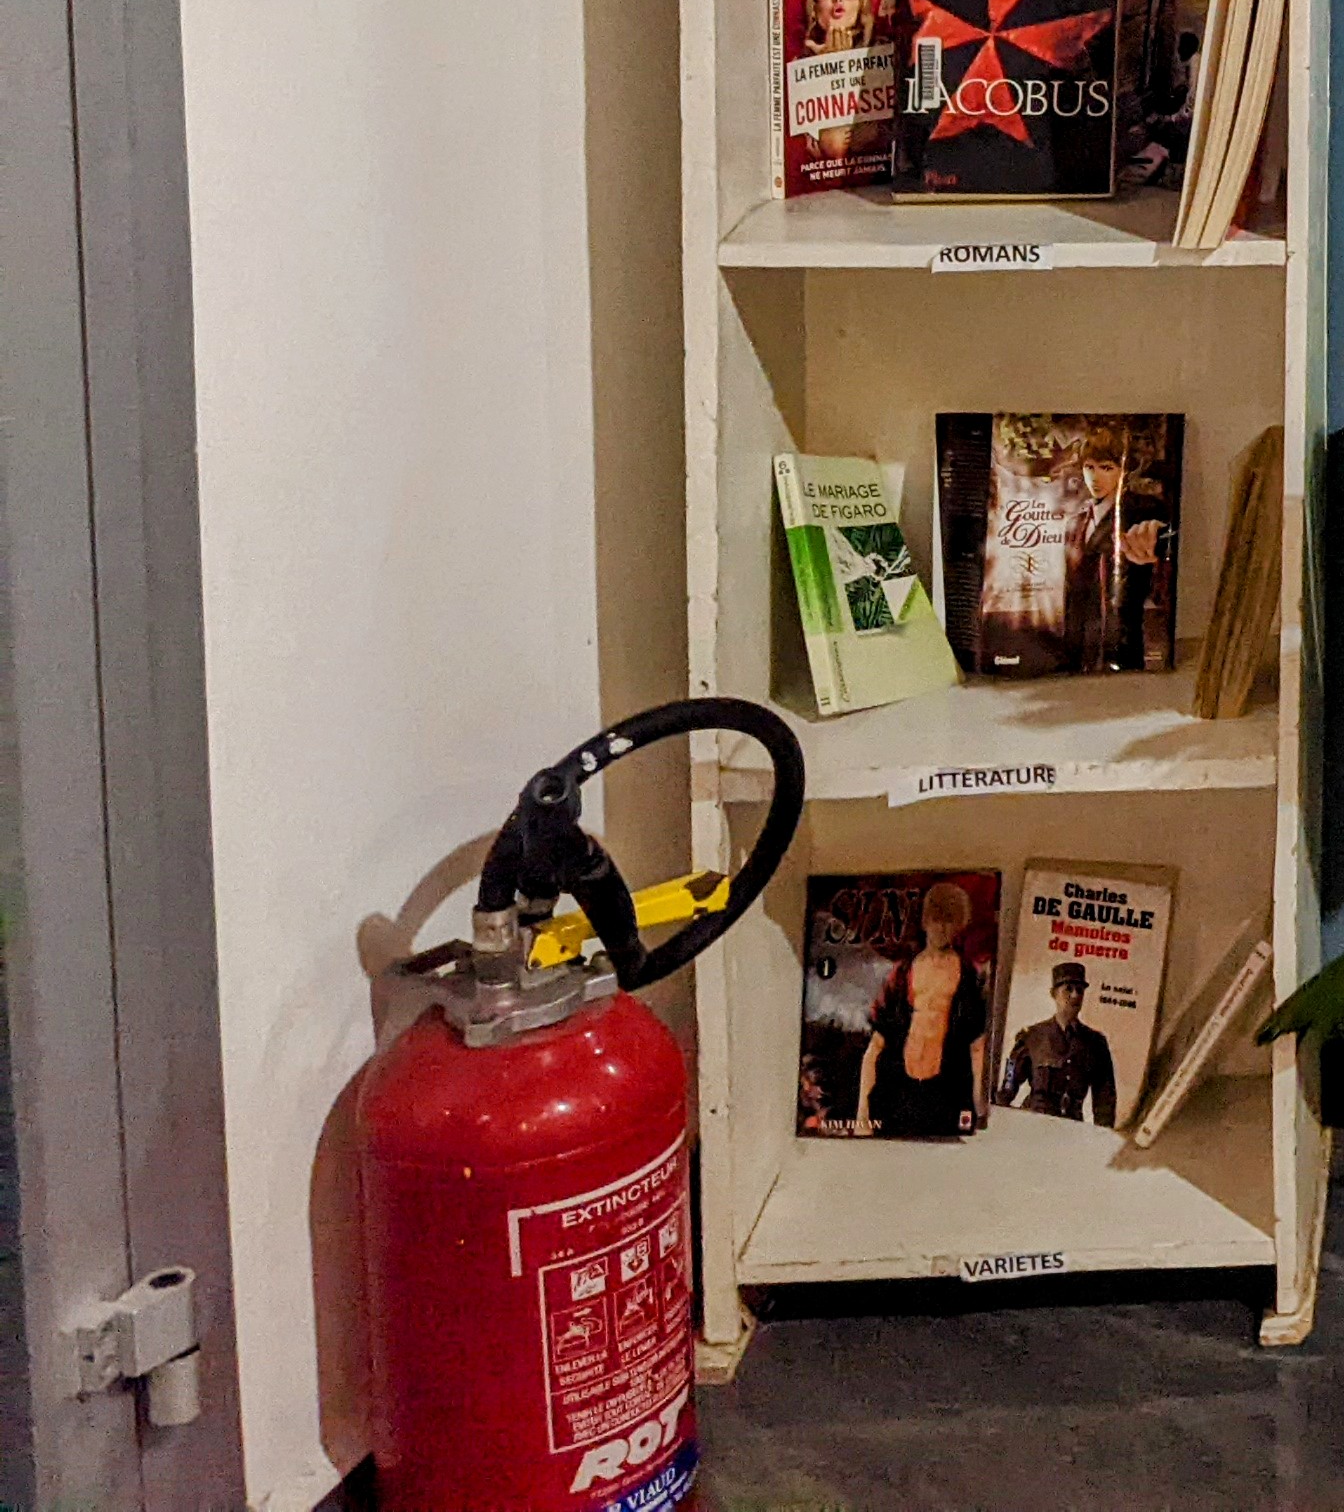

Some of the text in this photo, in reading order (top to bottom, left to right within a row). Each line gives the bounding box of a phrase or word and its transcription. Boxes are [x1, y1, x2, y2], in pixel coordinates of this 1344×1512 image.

[794, 54, 894, 82] LA FEMME PARFAIT
[830, 75, 867, 90] EST UNE
[795, 86, 896, 125] CONNASSE
[801, 161, 825, 173] PARCE
[826, 158, 843, 168] QUE
[809, 172, 821, 181] NE
[939, 245, 1041, 264] ROMANS
[803, 482, 881, 499] LE MARIAGE
[812, 503, 887, 519] DE FIGARO
[1031, 500, 1045, 509] Les
[998, 500, 1064, 538] Gouttes
[1001, 523, 1062, 548] de Dieu
[919, 767, 1055, 794] LITTERATURE
[1064, 882, 1128, 905] Charles
[1032, 896, 1155, 930] DE GAULLE
[1048, 936, 1128, 960] de guerre
[561, 1156, 678, 1228] EXTINCTEUR
[964, 1252, 1065, 1278] VARIETES
[626, 1467, 676, 1510] VIAUD
